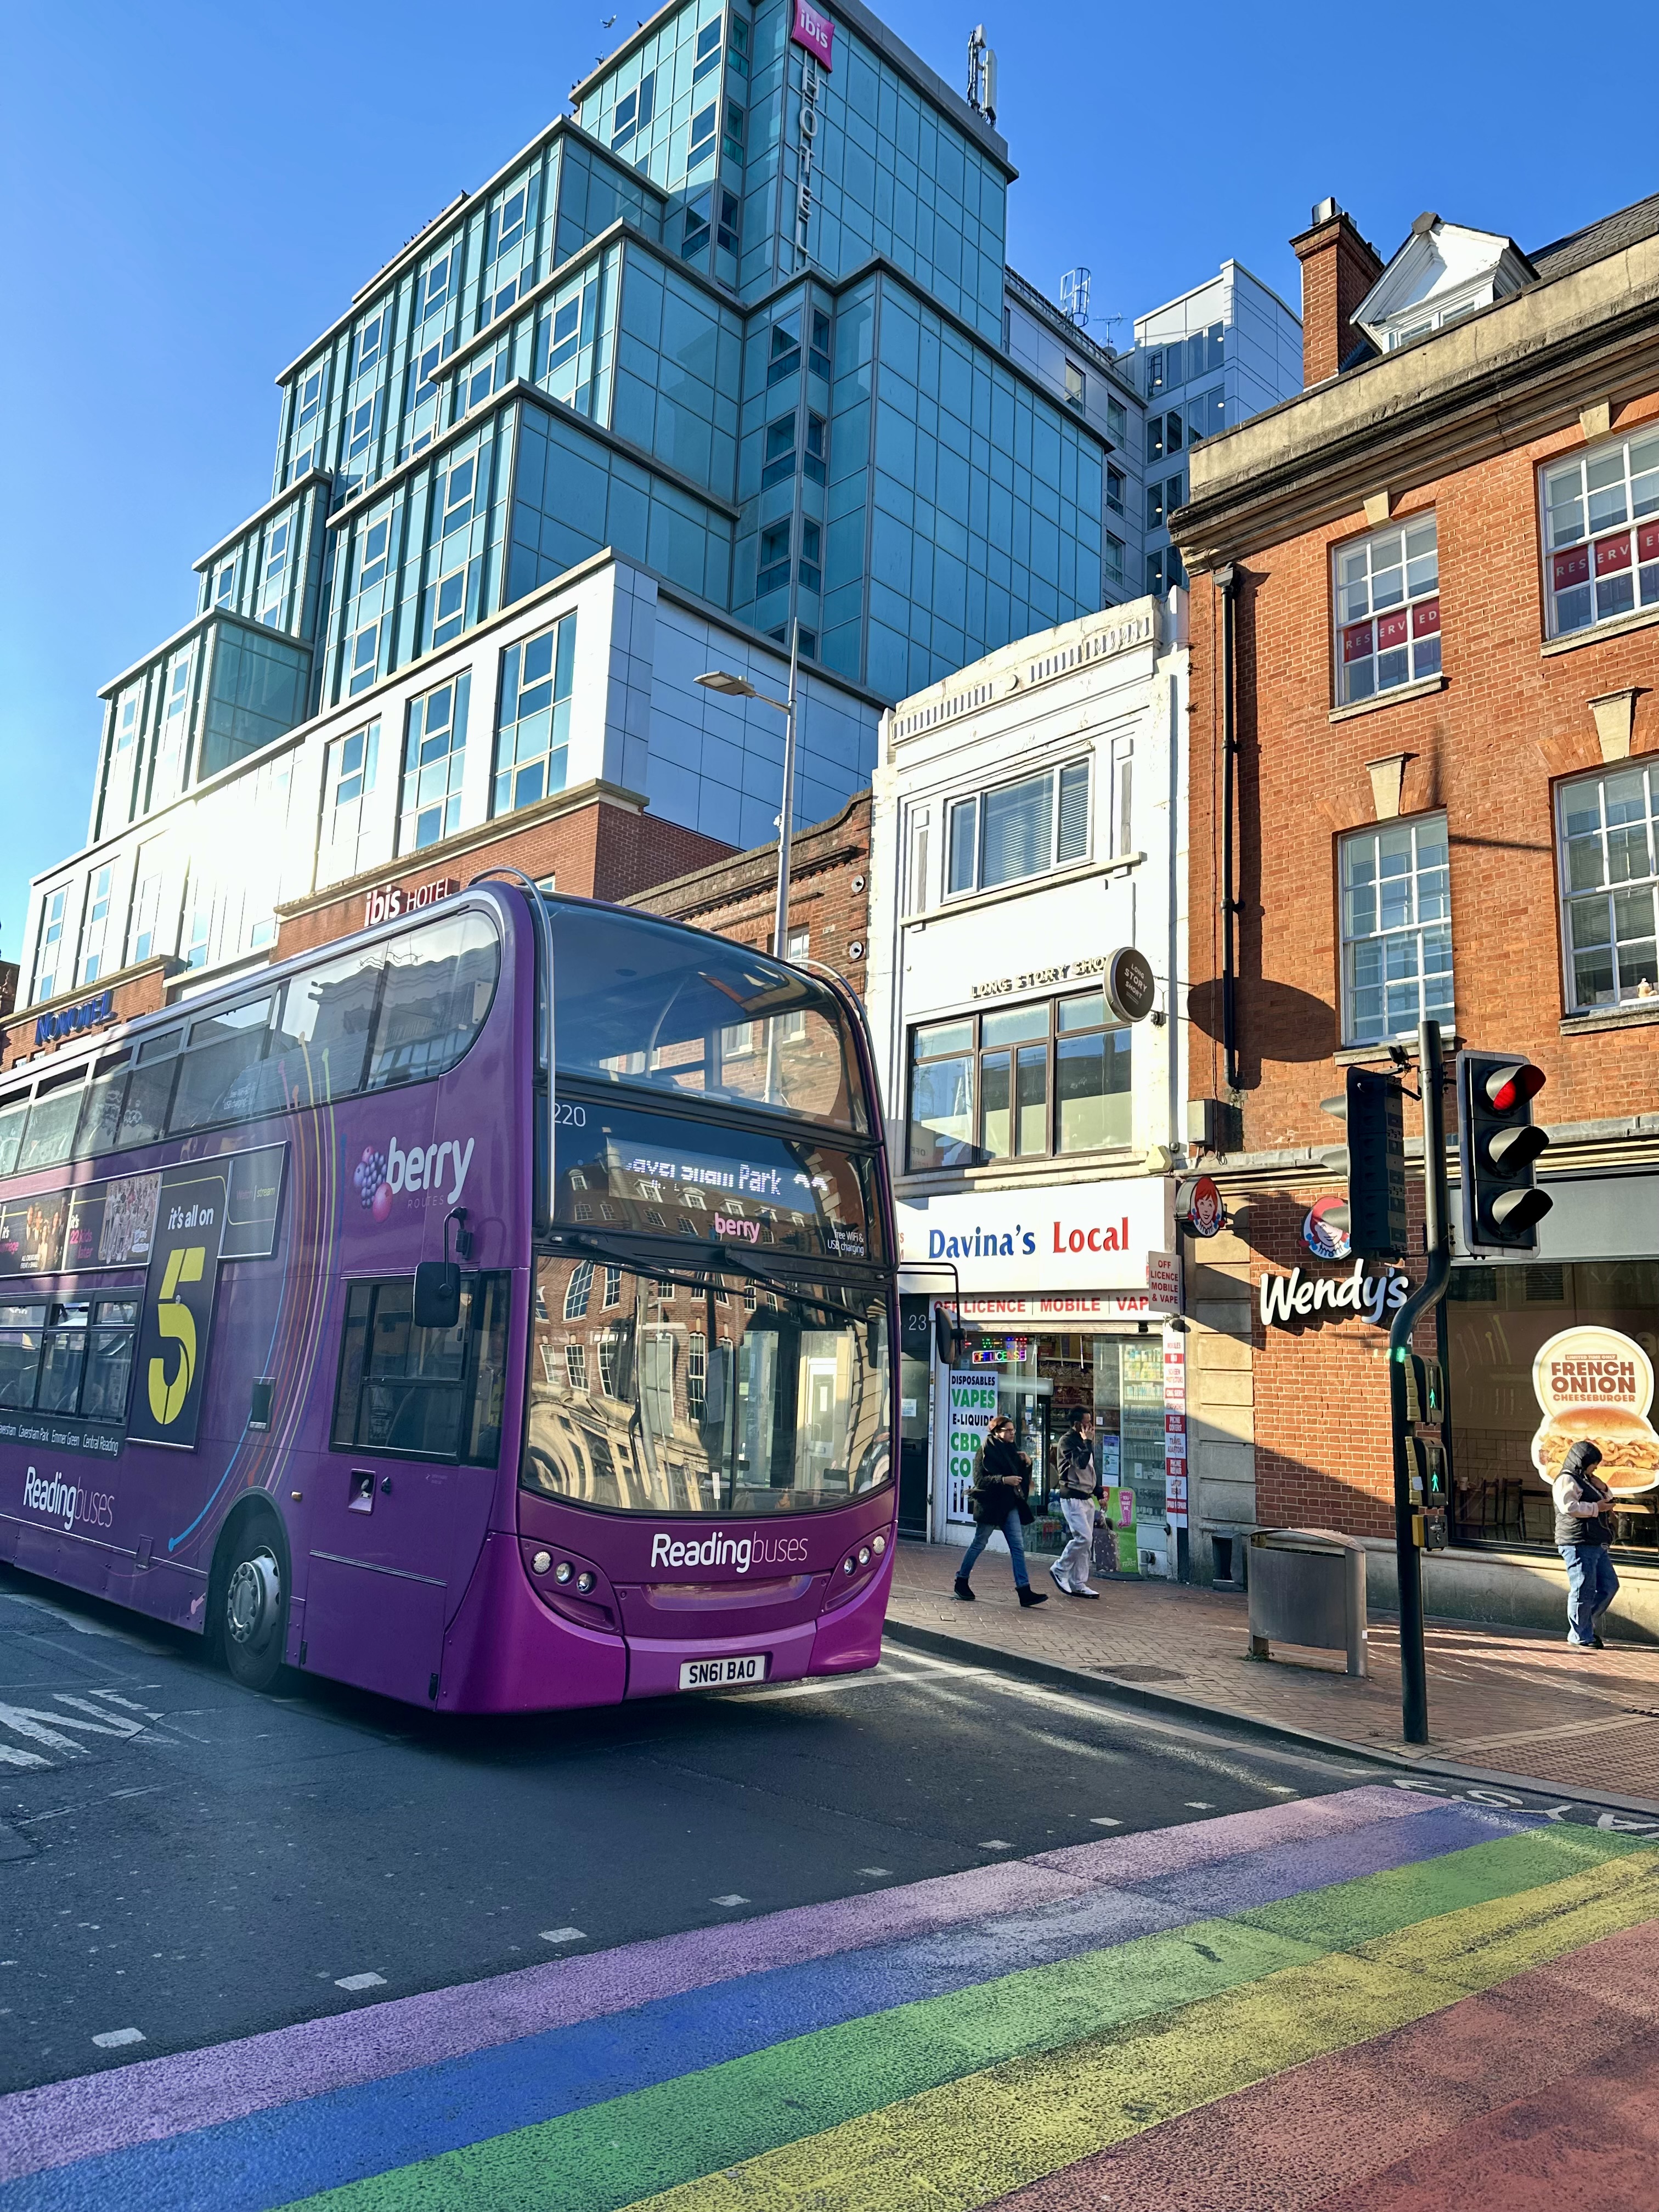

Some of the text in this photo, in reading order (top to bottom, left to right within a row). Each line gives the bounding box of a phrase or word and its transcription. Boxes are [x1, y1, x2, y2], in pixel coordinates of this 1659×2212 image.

[800, 9, 828, 49] ibis
[797, 65, 820, 255] HOTEL
[1556, 533, 1659, 577] RESERVE
[1346, 610, 1437, 650] RESERVED
[364, 878, 452, 927] ibis HOTEL
[970, 955, 1108, 997] LONG STORY SHO
[1124, 968, 1148, 992] STORY
[1131, 963, 1144, 979] LONG
[1125, 981, 1142, 998] SHORT
[386, 1136, 475, 1205] berry
[738, 1164, 782, 1195] Park
[407, 1195, 444, 1209] ROUTES
[167, 1204, 214, 1230] it's all on
[70, 1229, 79, 1244] 22
[714, 1212, 760, 1244] berry
[834, 1229, 865, 1243] free WiFi &
[928, 1216, 1130, 1260] Davina's Local
[827, 1239, 865, 1256] USB charging
[1158, 1260, 1171, 1269] OFF
[1150, 1270, 1178, 1282] LICENCE
[1151, 1282, 1178, 1293] MOBILE
[1260, 1258, 1409, 1325] Wendy's
[963, 1299, 1026, 1313] LICENCE
[1040, 1297, 1101, 1312] MOBILE
[1115, 1296, 1149, 1311] VAP
[1152, 1293, 1178, 1305] & VAPE
[909, 1314, 927, 1331] 23
[148, 1246, 205, 1425] 5
[974, 1351, 1025, 1362] OFF LICENSE
[1551, 1361, 1635, 1376] FRENCH
[951, 1375, 995, 1386] DISPOSABLES
[1551, 1376, 1636, 1393] ONION
[951, 1389, 996, 1409] VAPES
[1553, 1394, 1635, 1402] CHEESEBURGER
[0, 1422, 49, 1442] aversham Caversham Park
[51, 1429, 80, 1446] Emmer Green
[951, 1432, 981, 1452] CBD
[83, 1434, 119, 1457] Central Reading
[950, 1457, 974, 1477] CO
[689, 1660, 756, 1684] SN61 BAO
